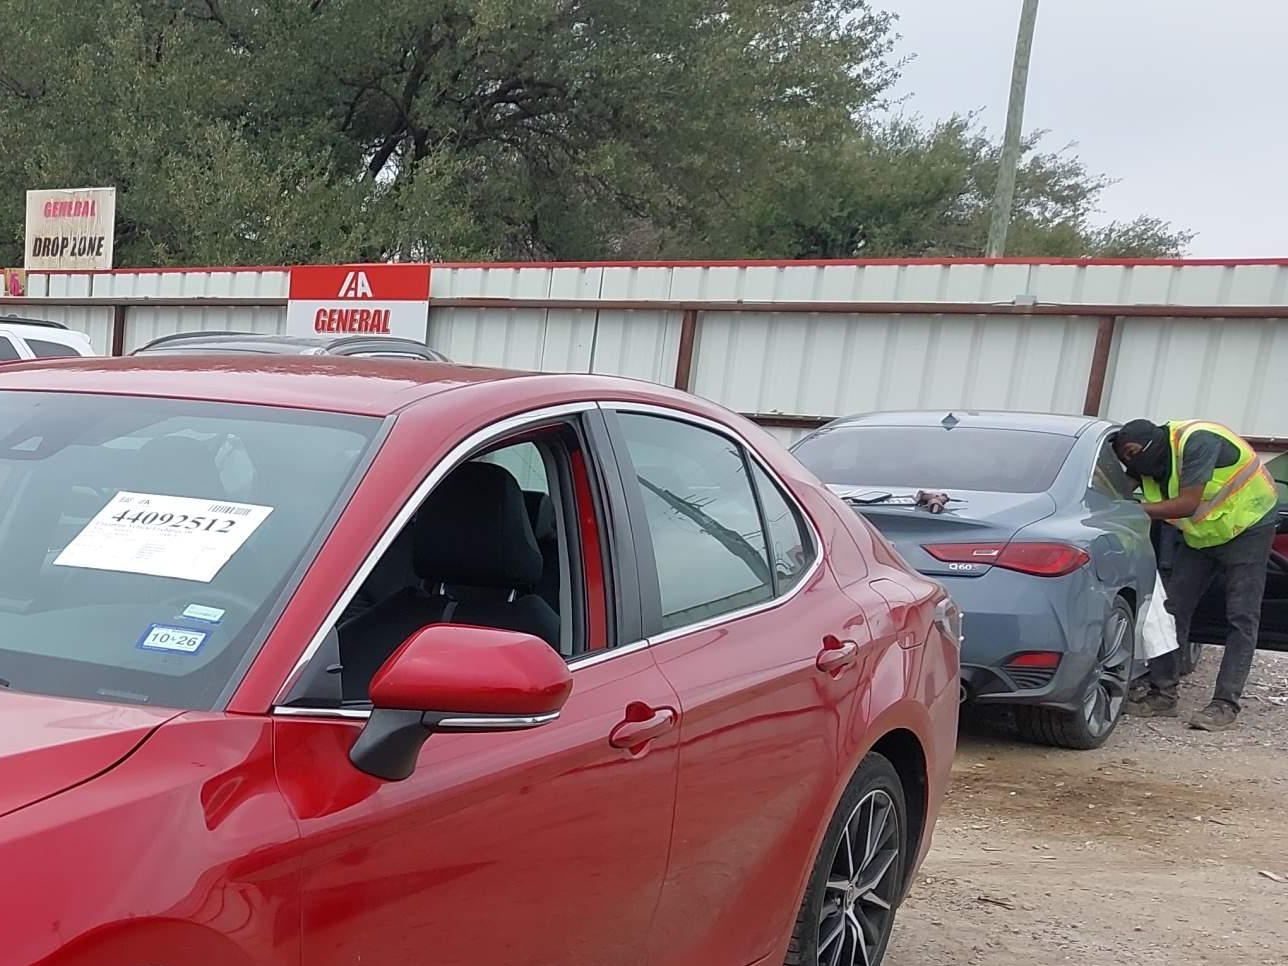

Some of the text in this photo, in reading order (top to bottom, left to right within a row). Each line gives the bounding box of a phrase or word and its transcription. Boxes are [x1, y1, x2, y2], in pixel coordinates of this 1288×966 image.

[43, 200, 96, 218] GENERAL
[32, 235, 105, 257] DROP ZONE
[314, 307, 392, 335] GENERAL
[111, 509, 237, 534] 44092512
[948, 563, 972, 571] Q60
